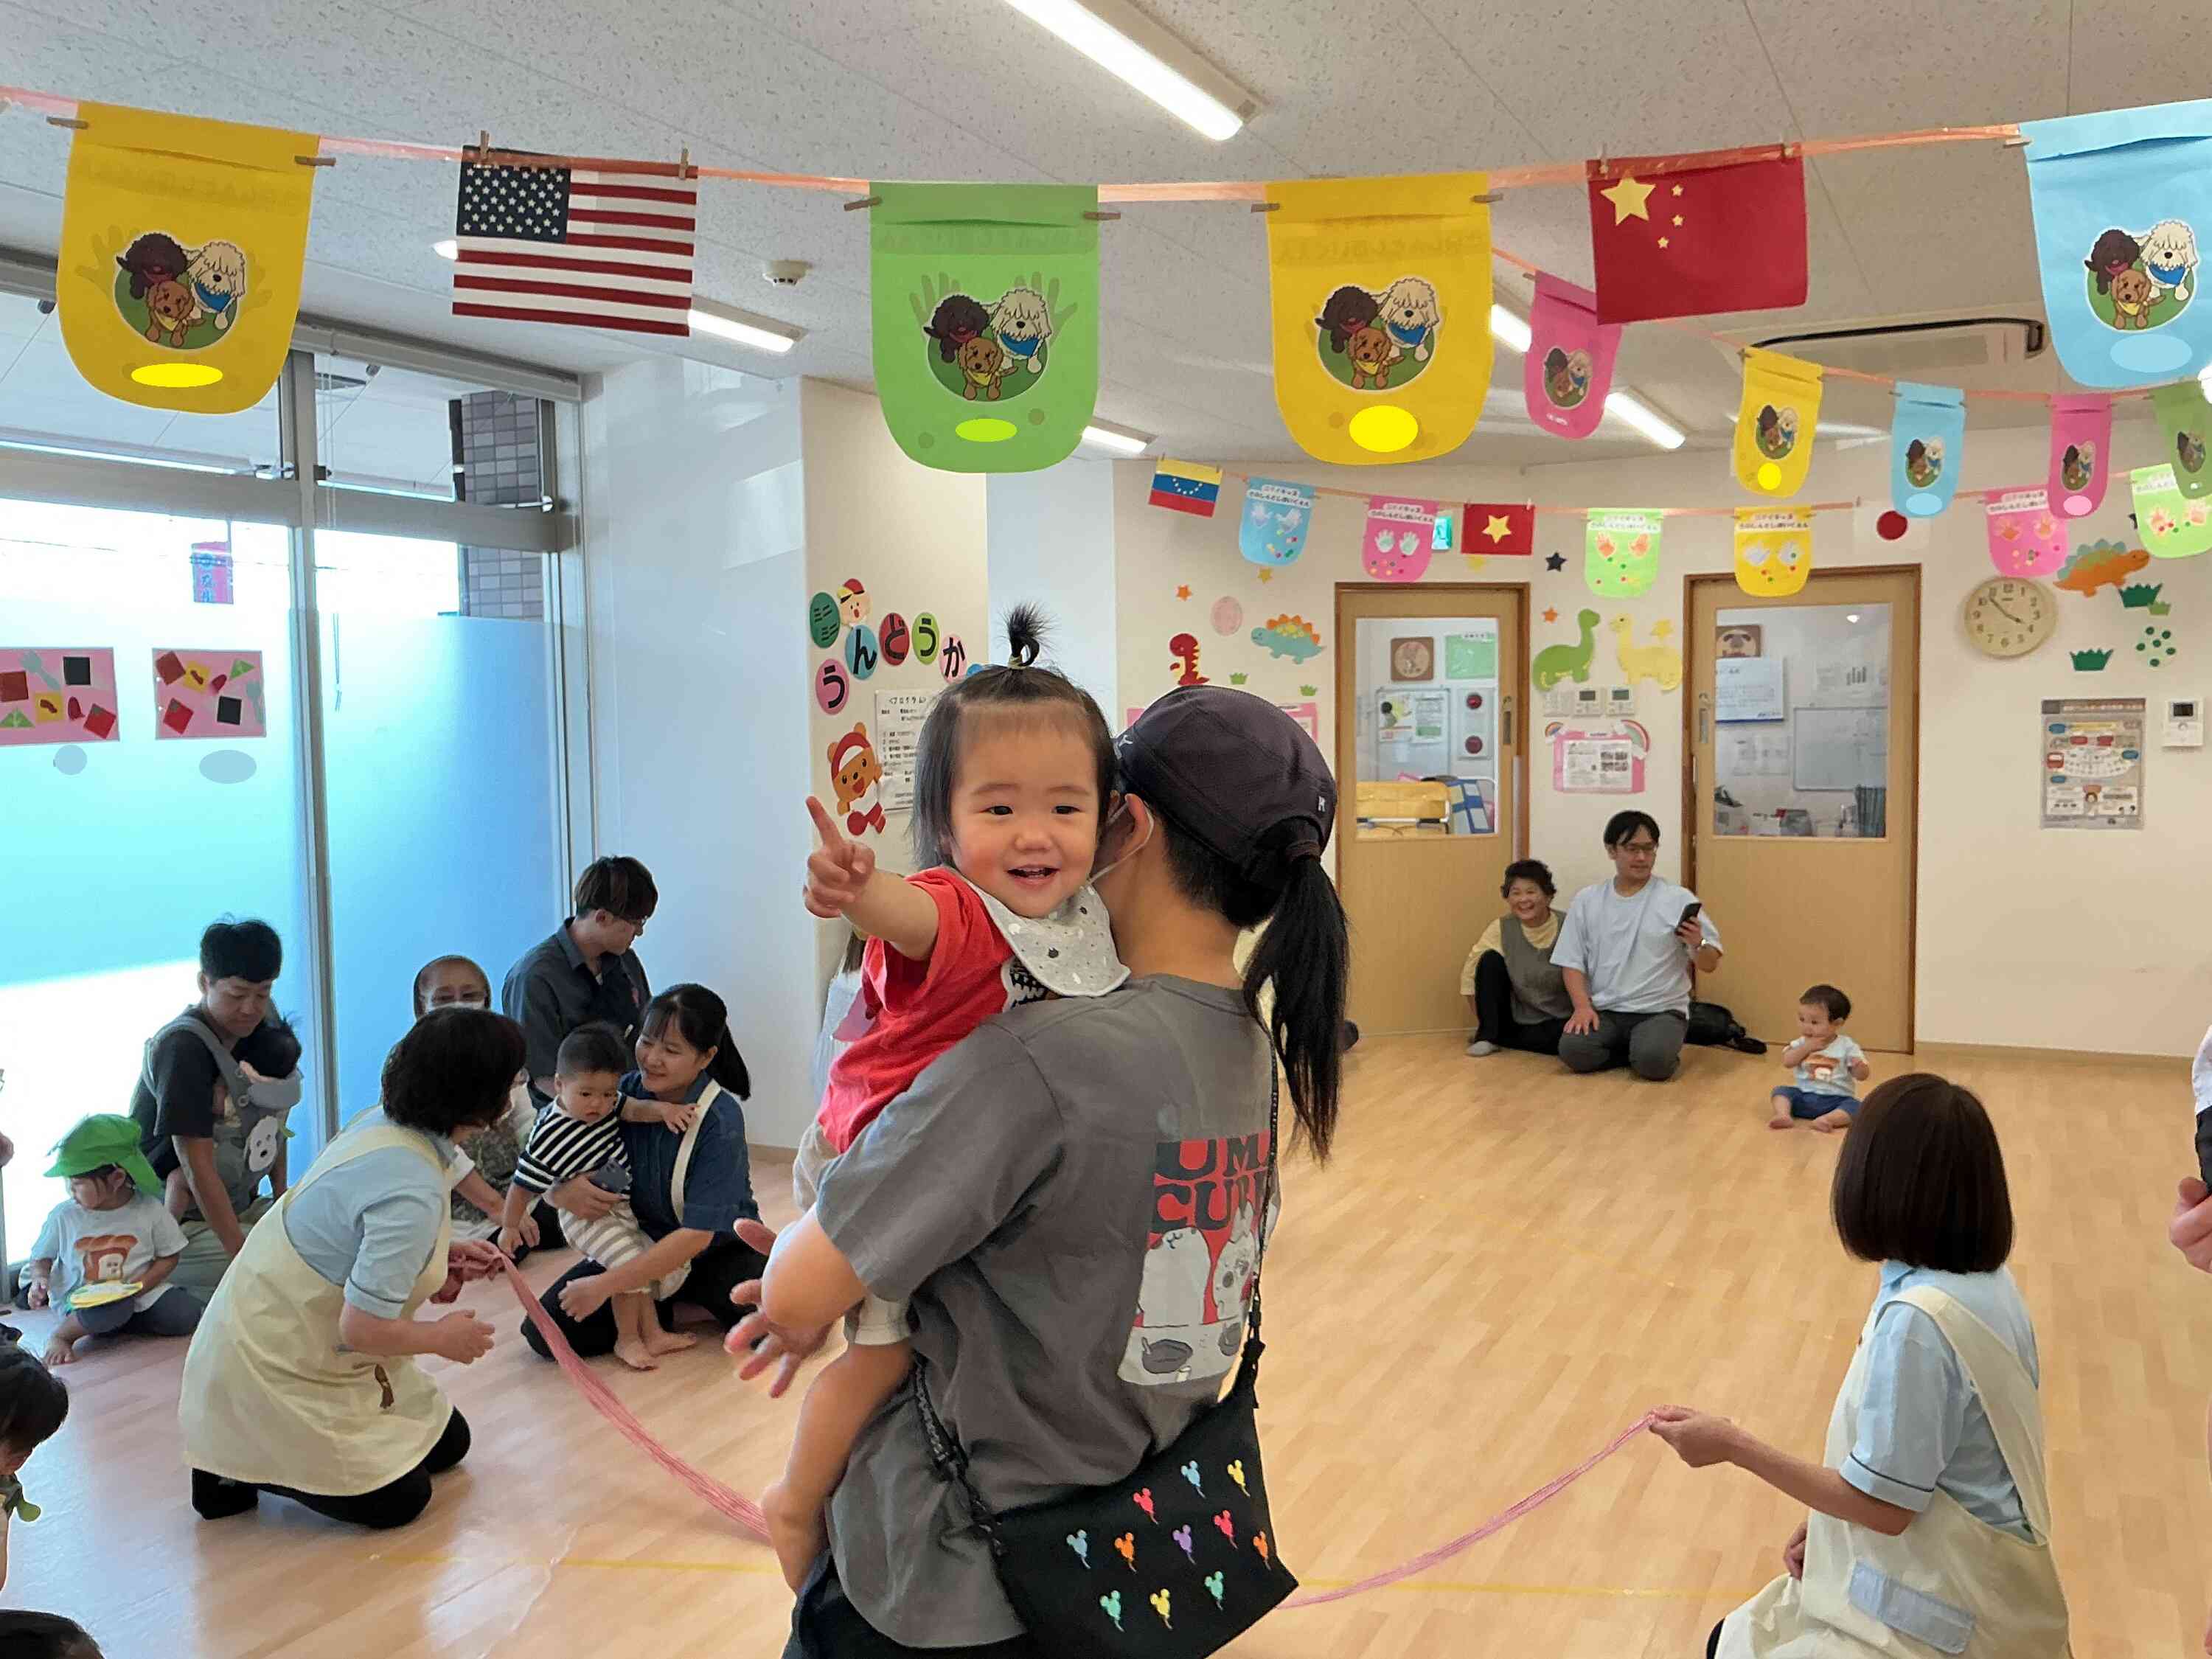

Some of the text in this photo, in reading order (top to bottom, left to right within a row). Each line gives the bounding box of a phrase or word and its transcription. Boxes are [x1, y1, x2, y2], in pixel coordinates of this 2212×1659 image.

[822, 612, 966, 709] うんどうか
